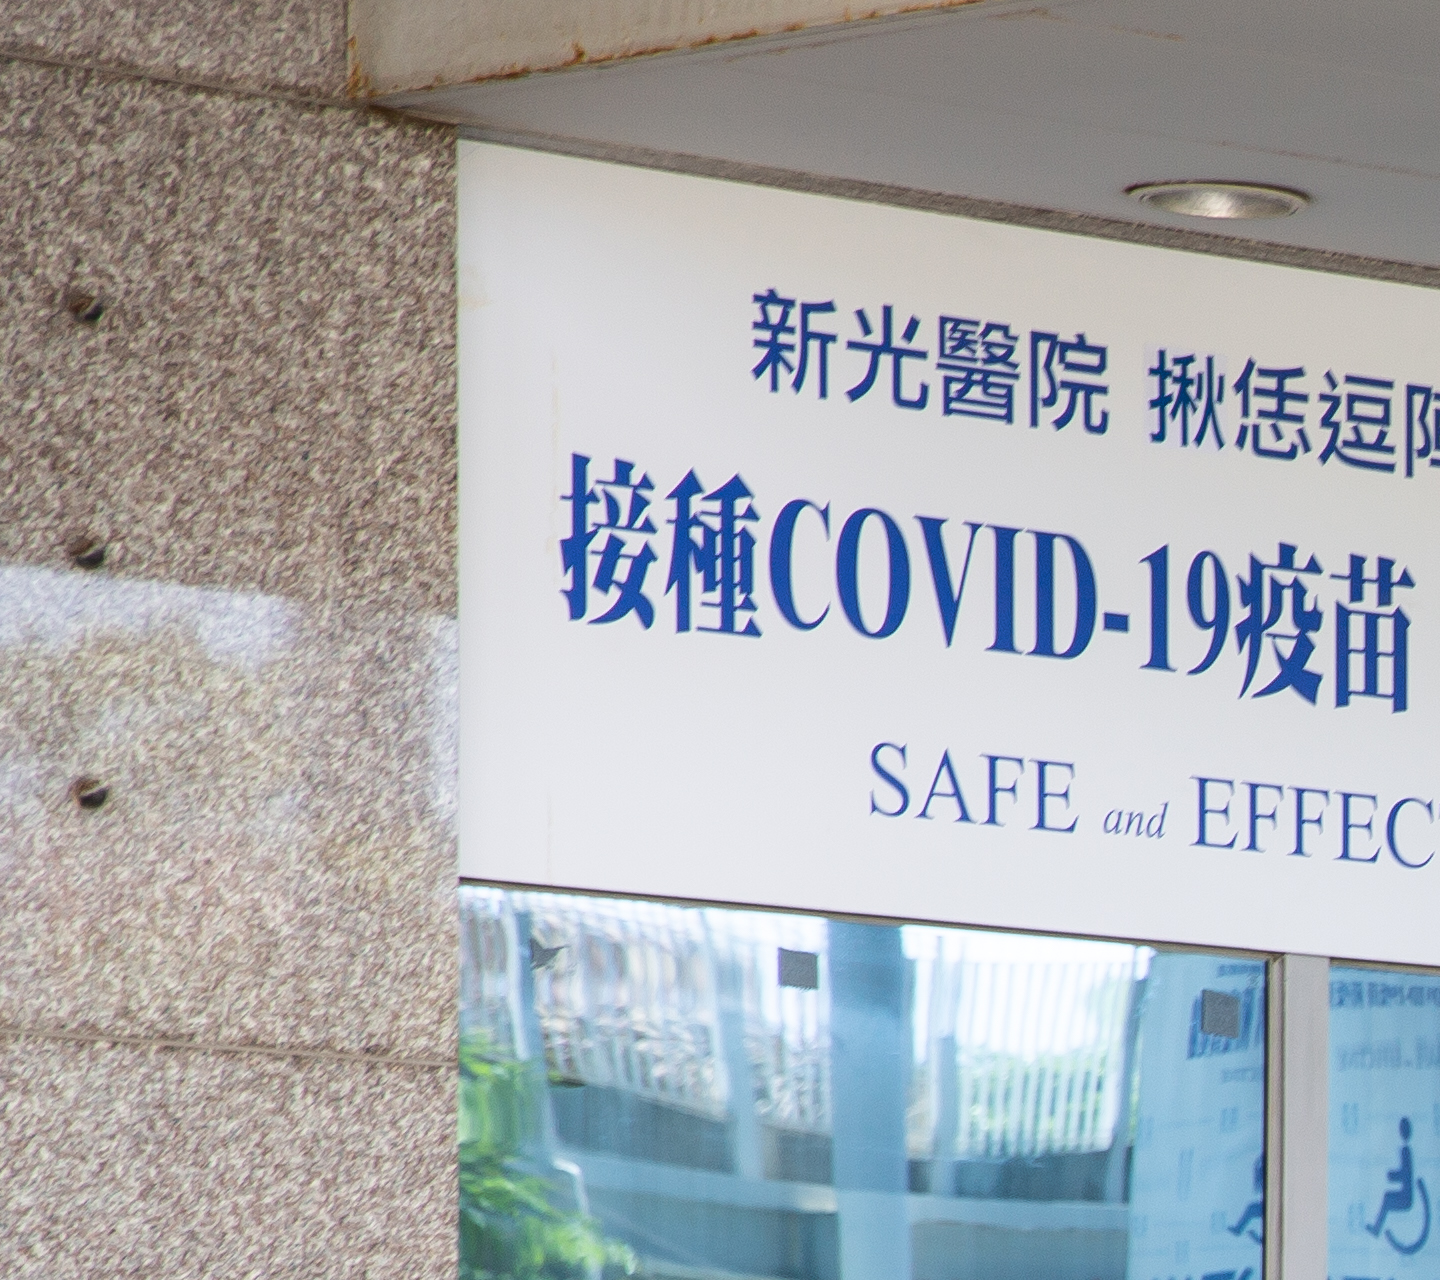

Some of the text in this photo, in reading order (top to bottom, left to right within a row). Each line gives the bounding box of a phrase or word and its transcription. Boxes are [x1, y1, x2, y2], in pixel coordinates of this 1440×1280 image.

[750, 287, 1110, 435] 新光醫院
[557, 452, 1409, 713] 接種COVID-19疫苗
[870, 741, 1079, 835] SAFE
[1102, 802, 1167, 840] and
